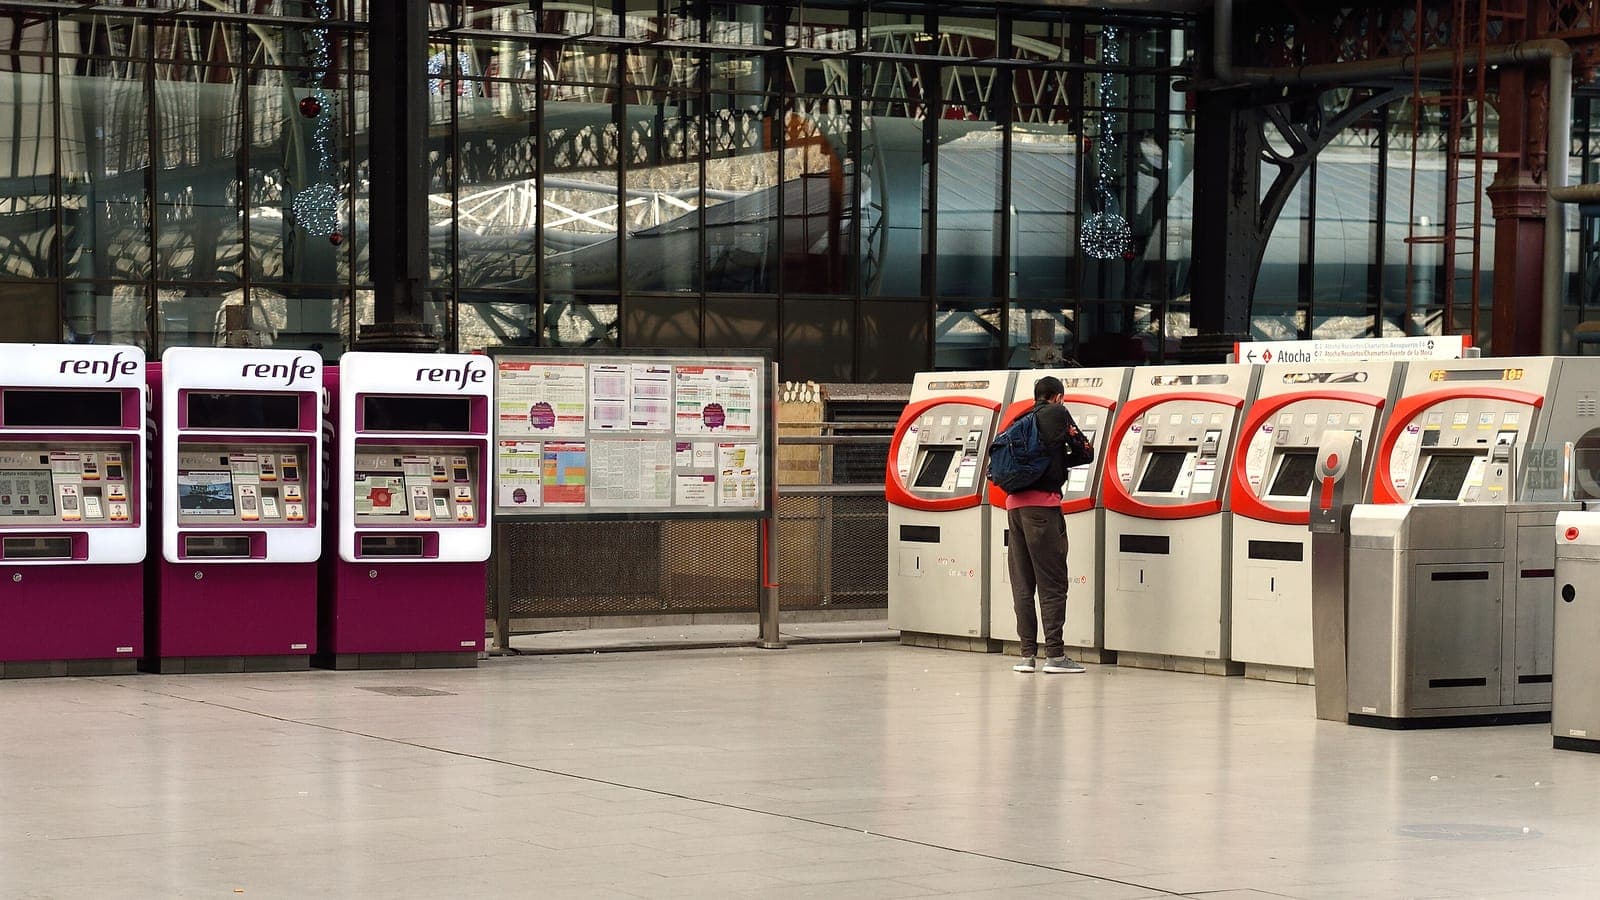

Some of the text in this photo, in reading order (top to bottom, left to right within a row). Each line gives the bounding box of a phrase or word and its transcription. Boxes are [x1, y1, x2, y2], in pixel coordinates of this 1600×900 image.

[60, 352, 137, 383] renfe
[1278, 349, 1311, 363] Atocha
[242, 357, 315, 386] renfe
[416, 361, 486, 390] renfe
